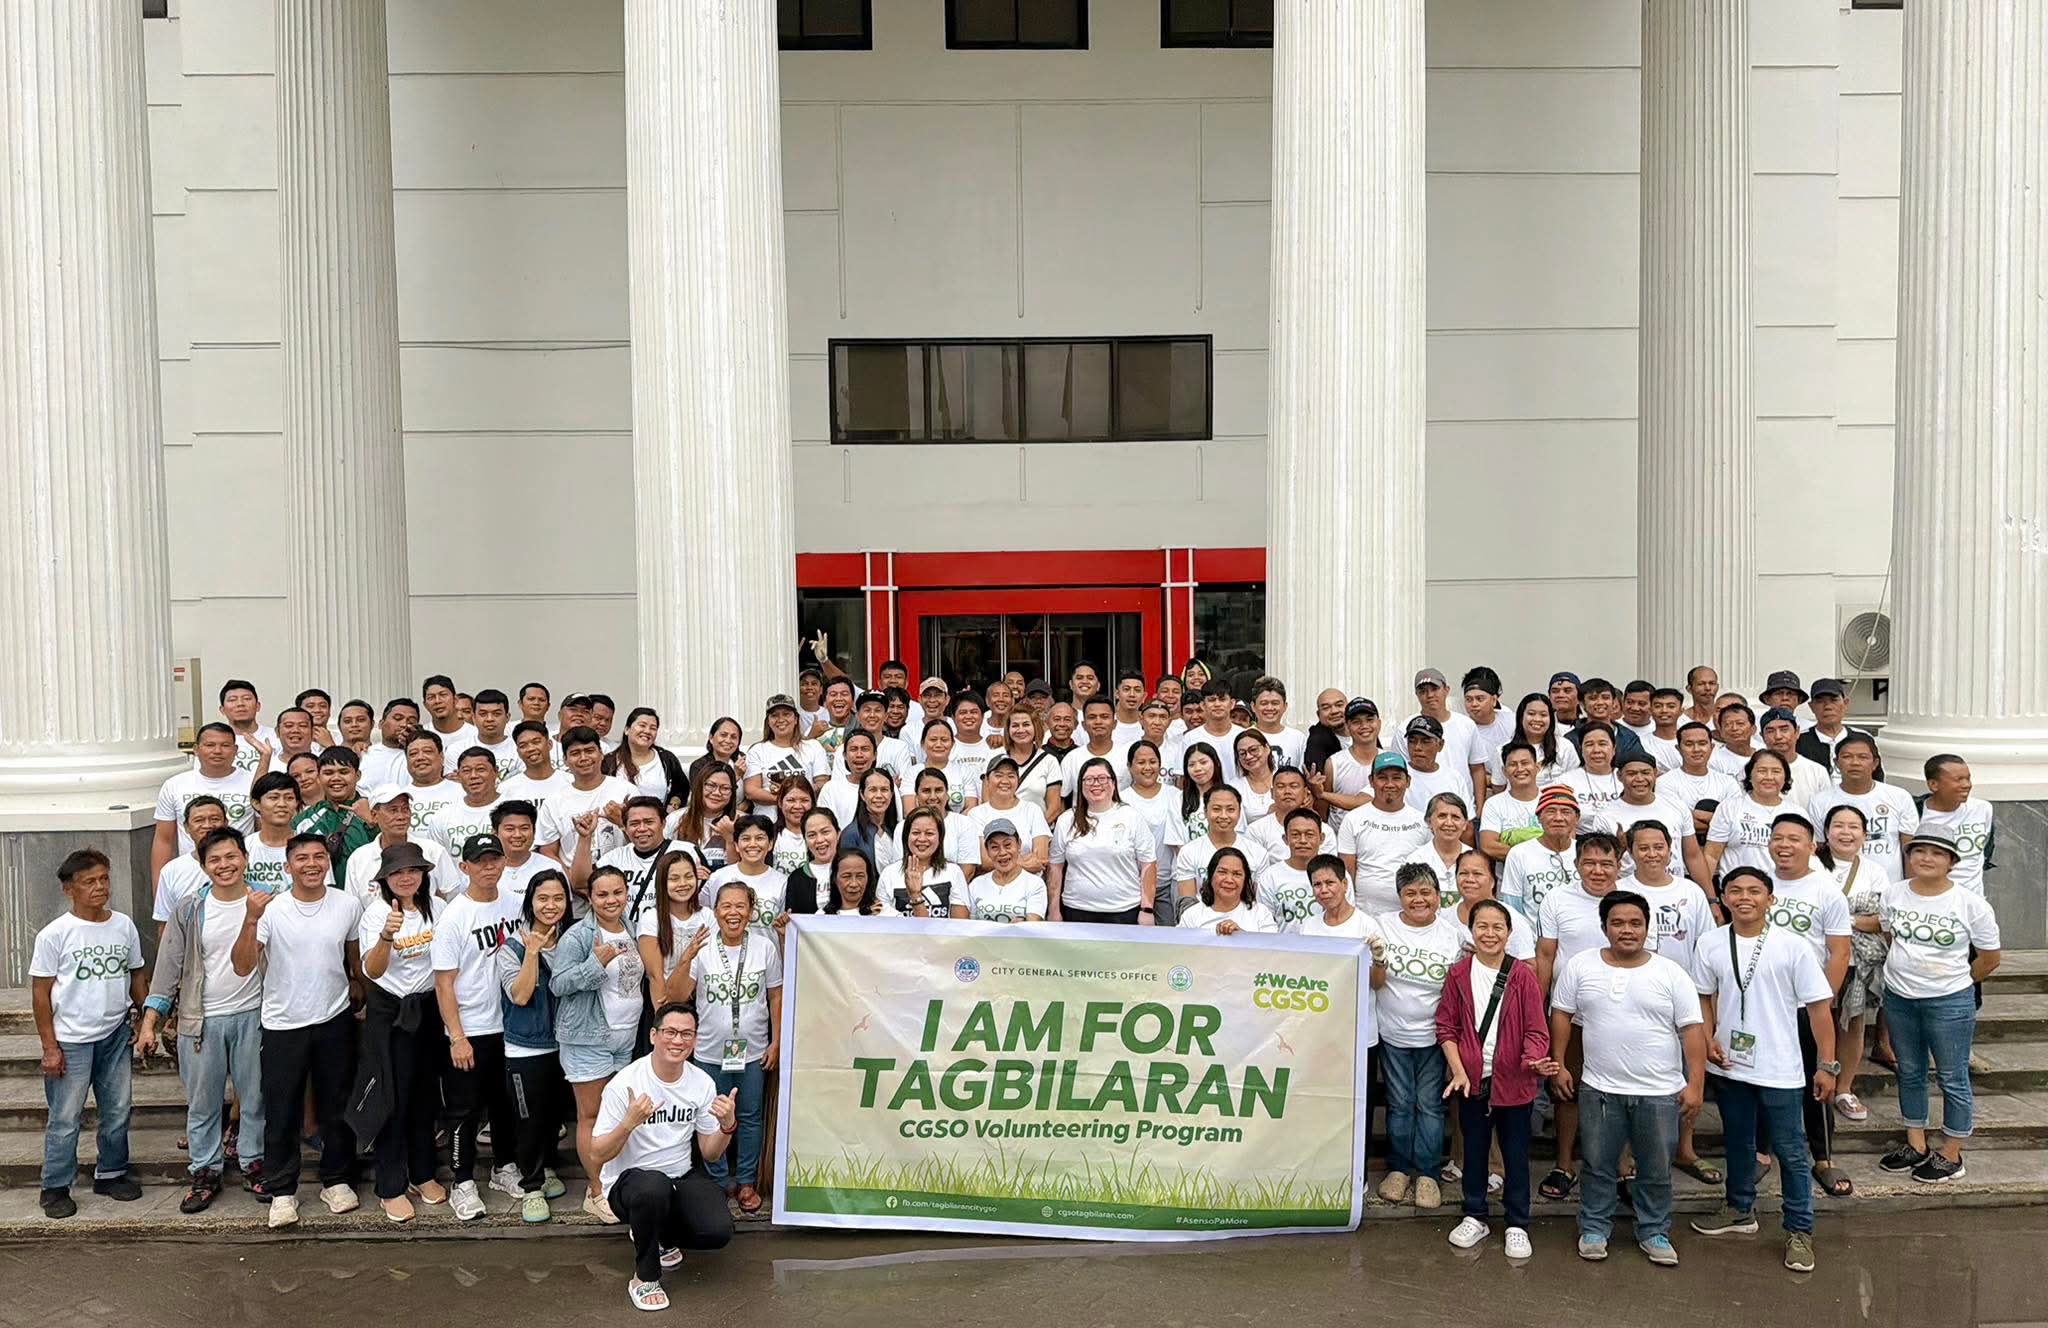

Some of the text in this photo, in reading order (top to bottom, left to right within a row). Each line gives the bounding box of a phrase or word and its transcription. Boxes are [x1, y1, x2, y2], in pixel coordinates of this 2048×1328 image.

[72, 944, 131, 962] PROJEC
[1385, 943, 1449, 963] ROJECT
[991, 966, 1014, 976] CITY
[1018, 967, 1064, 978] GENERAL
[1067, 968, 1117, 980] SERVICES
[1120, 971, 1158, 982] OFFICE
[1253, 972, 1329, 992] #WeAre
[1252, 988, 1330, 1013] CGSO
[919, 999, 1223, 1057] I AM FOR
[852, 1057, 1291, 1120] TAGBILARAN
[899, 1119, 1243, 1146] CGSO Volunteering Program
[902, 1199, 998, 1213] fb.com/tagbilarancitygso
[1057, 1208, 1135, 1221] cgsotagbilaran.com
[1175, 1215, 1249, 1226] #AsensoPaMore
